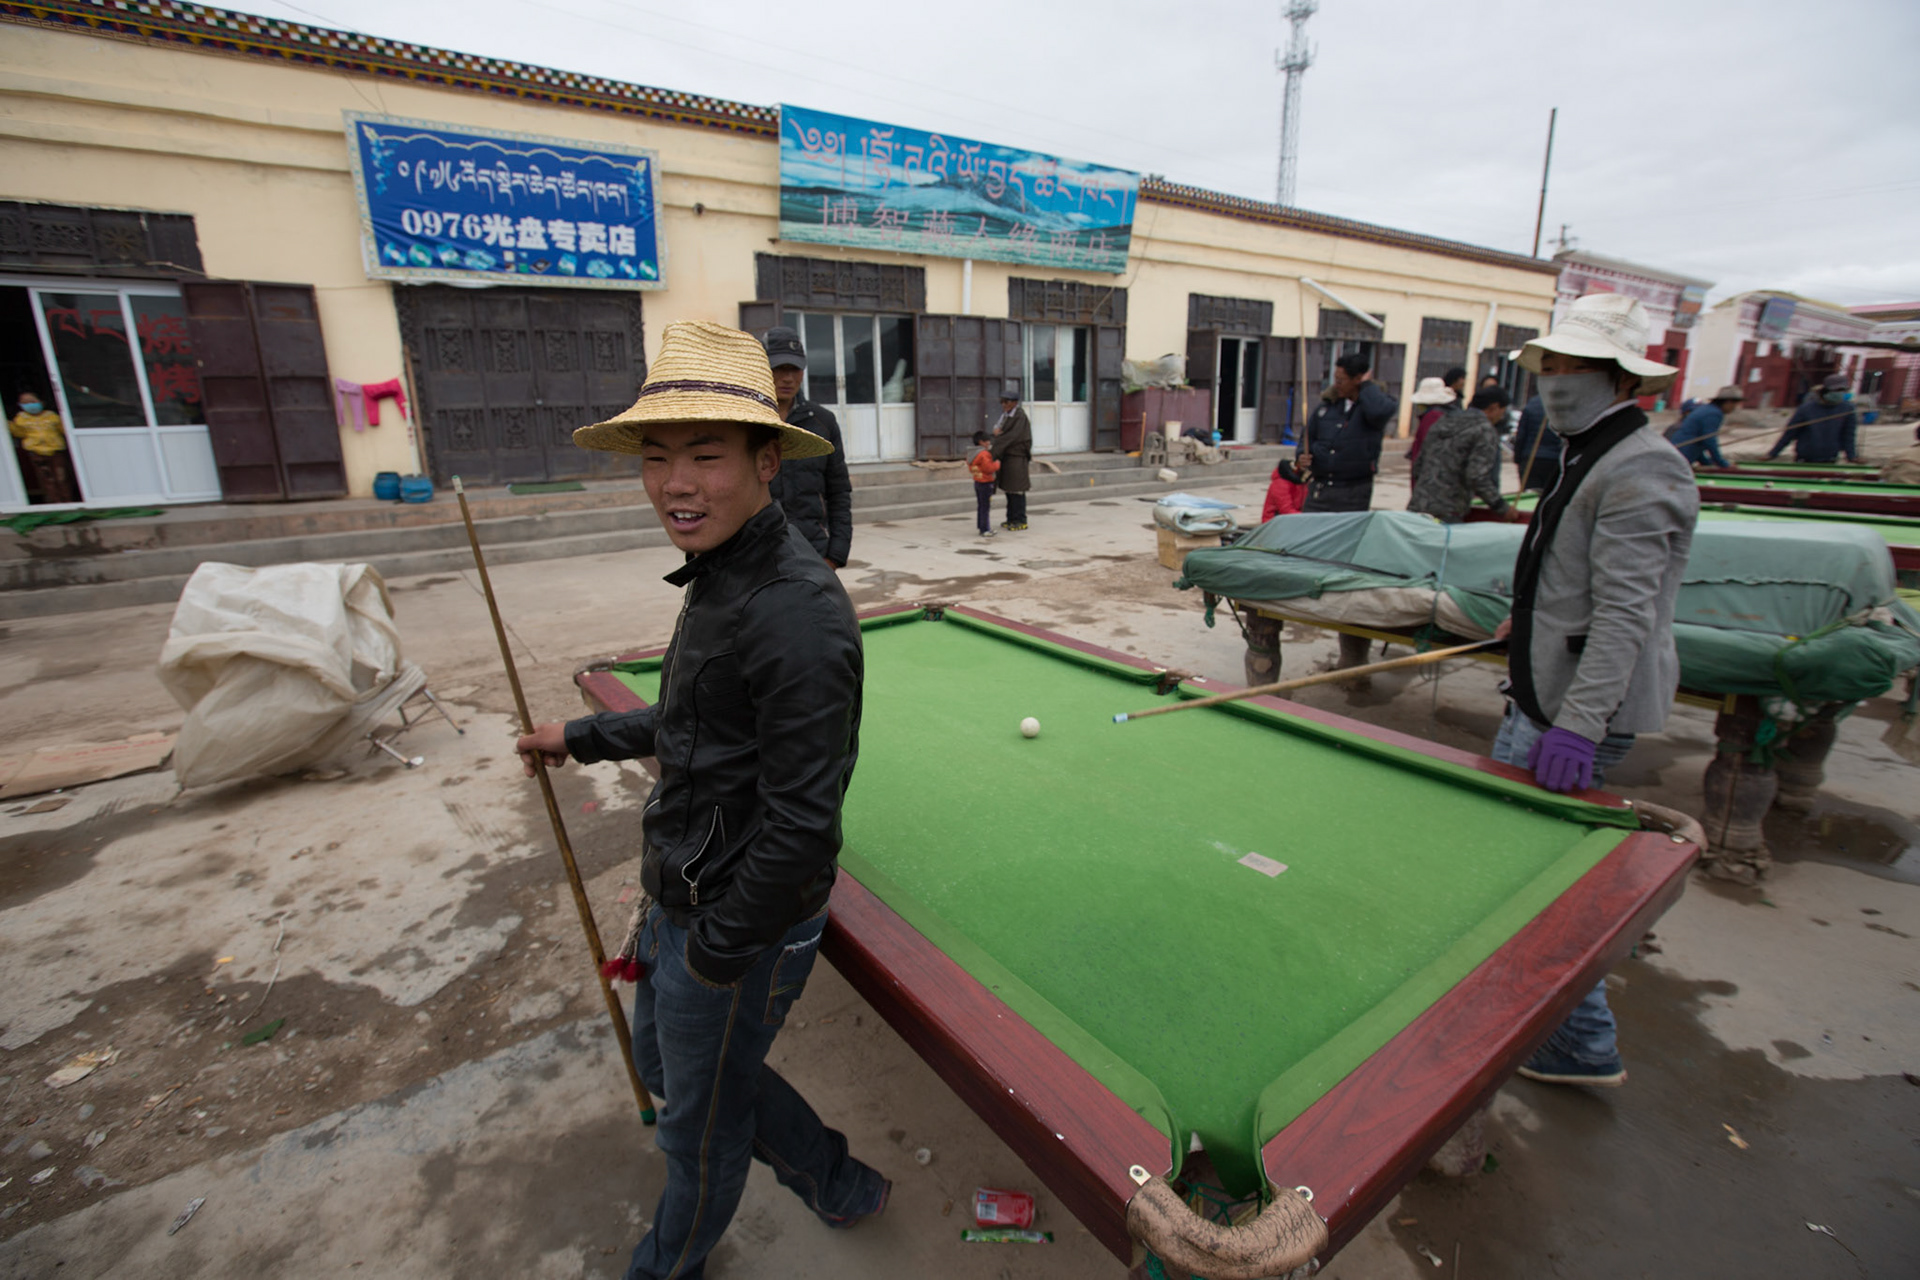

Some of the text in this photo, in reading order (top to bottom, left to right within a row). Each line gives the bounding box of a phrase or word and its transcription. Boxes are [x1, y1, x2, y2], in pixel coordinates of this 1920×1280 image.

[401, 208, 636, 257] 0976光盘专卖店
[137, 313, 201, 404] 烧烤
